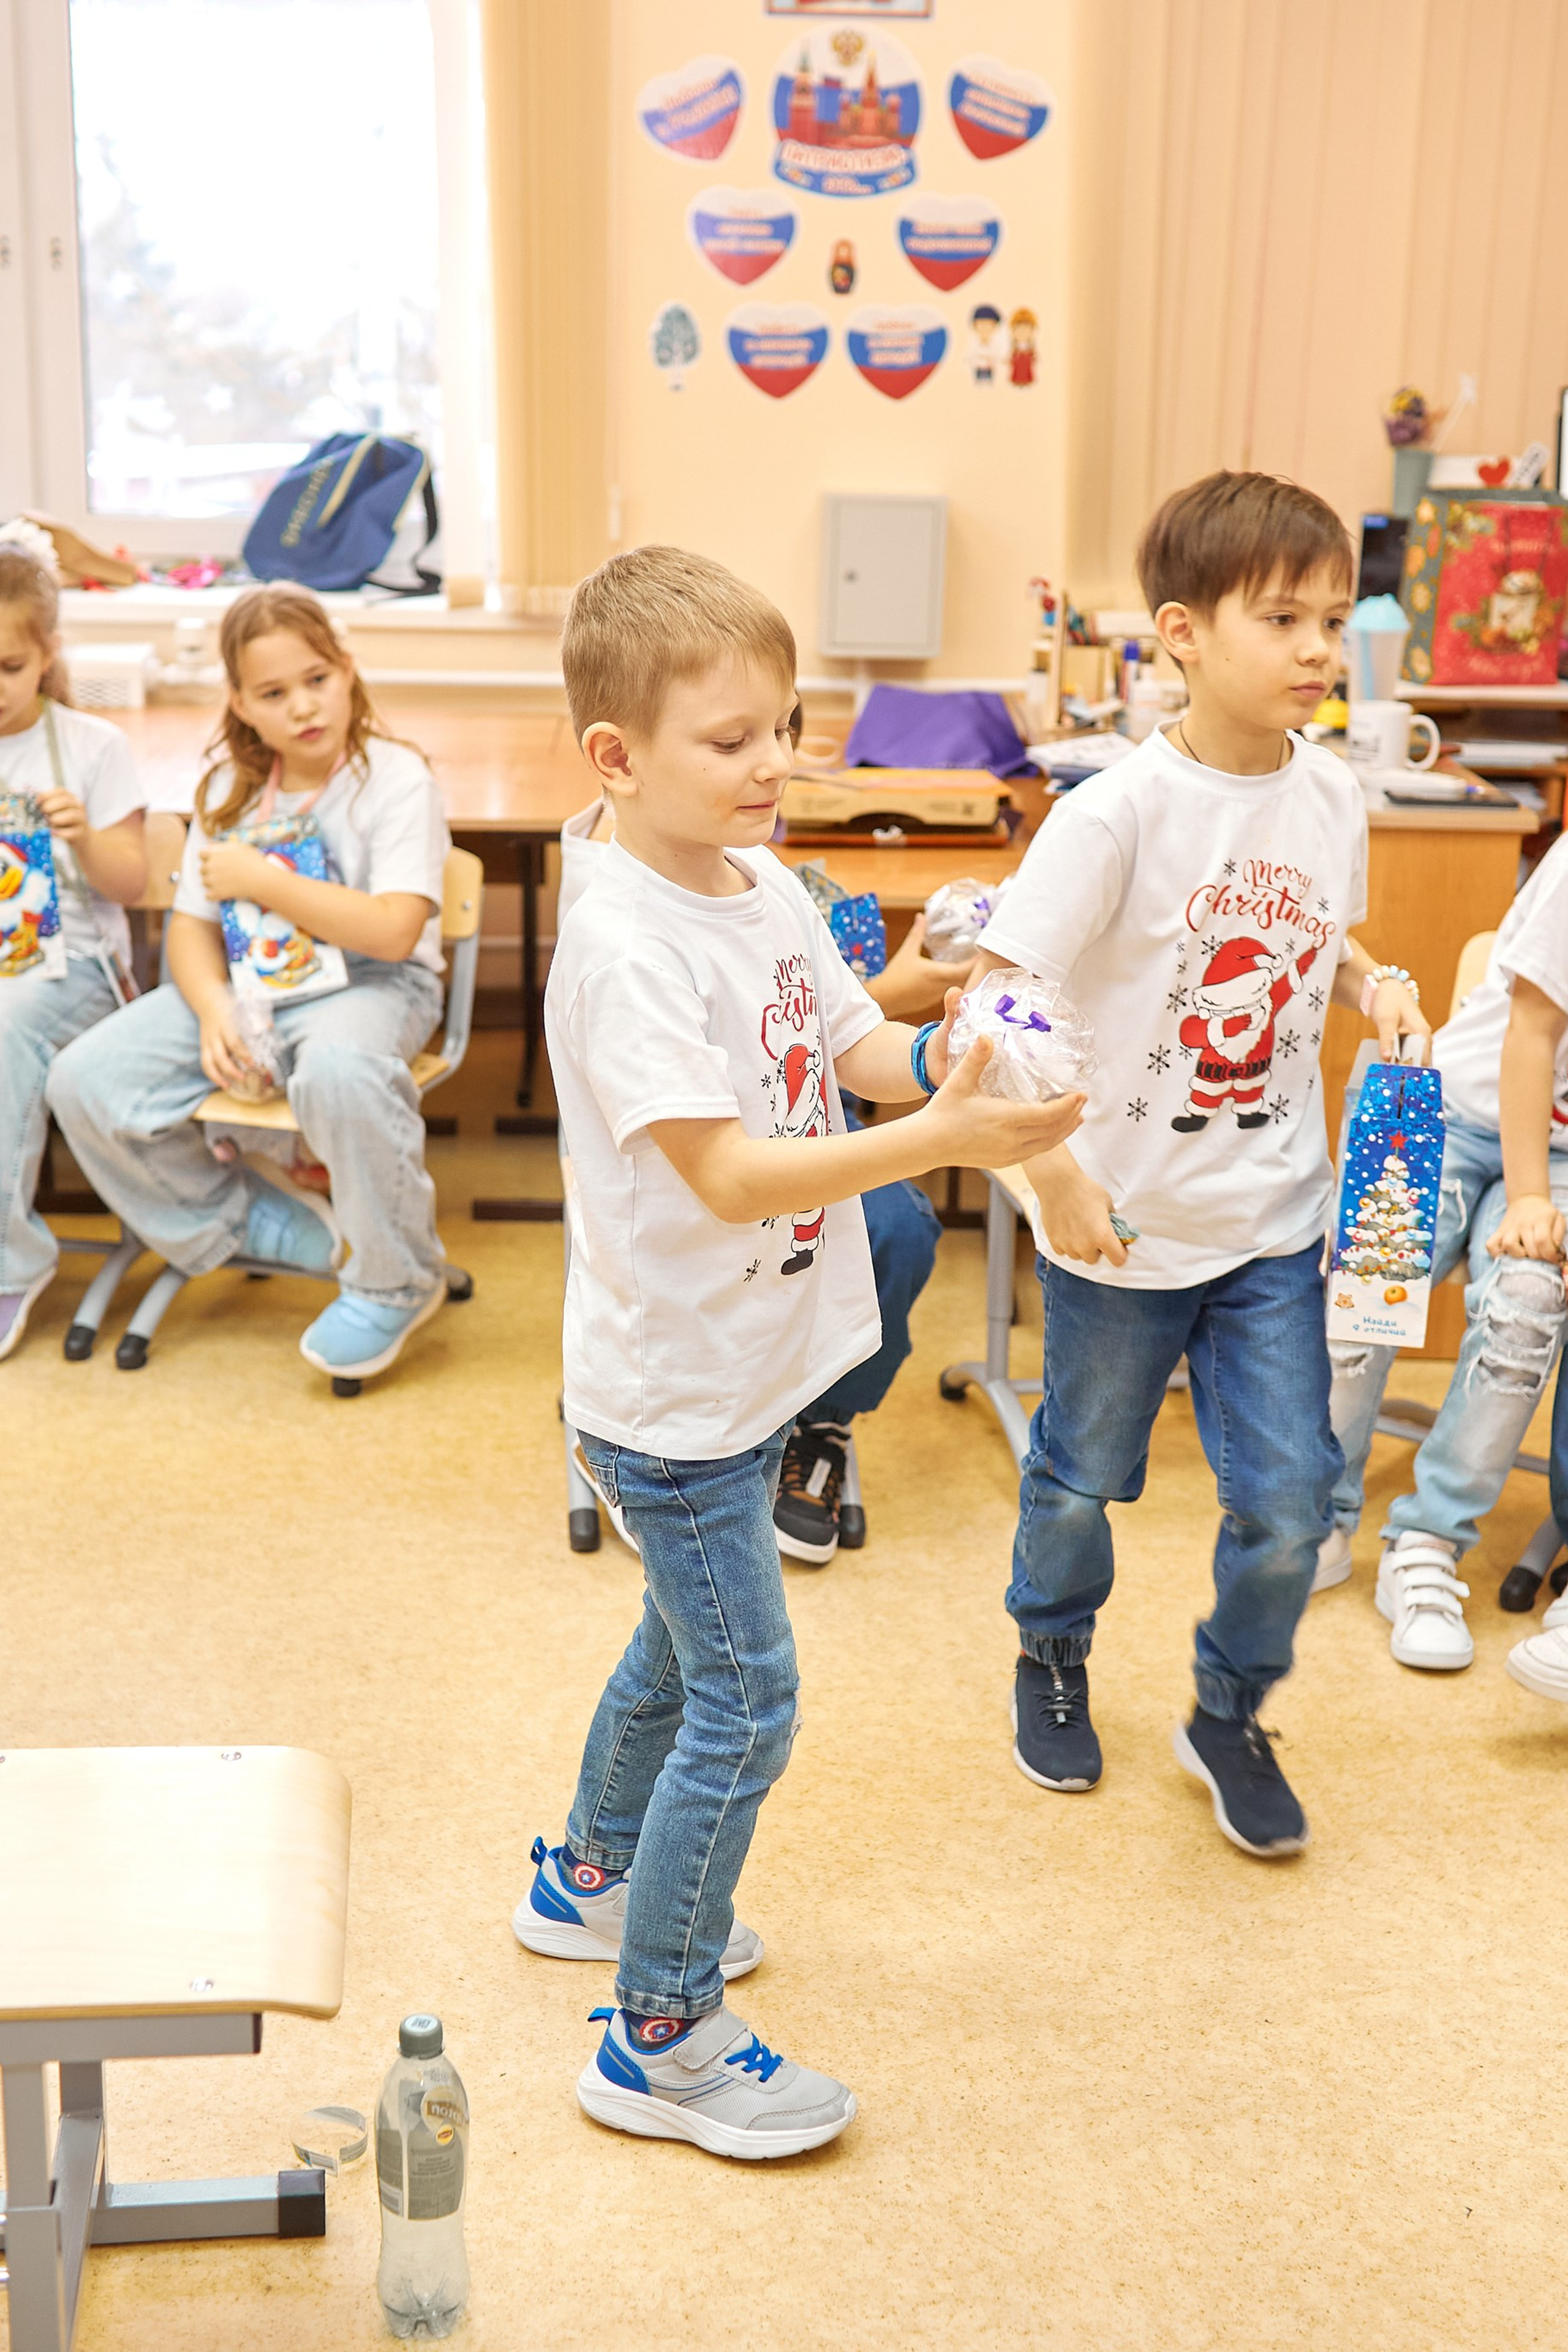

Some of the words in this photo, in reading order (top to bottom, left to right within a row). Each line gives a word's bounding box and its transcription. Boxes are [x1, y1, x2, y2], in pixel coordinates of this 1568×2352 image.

[1243, 859, 1313, 899] Merry
[1185, 884, 1336, 949] Christmas
[1363, 1316, 1397, 1327] Найди
[1363, 1327, 1406, 1336] отличий
